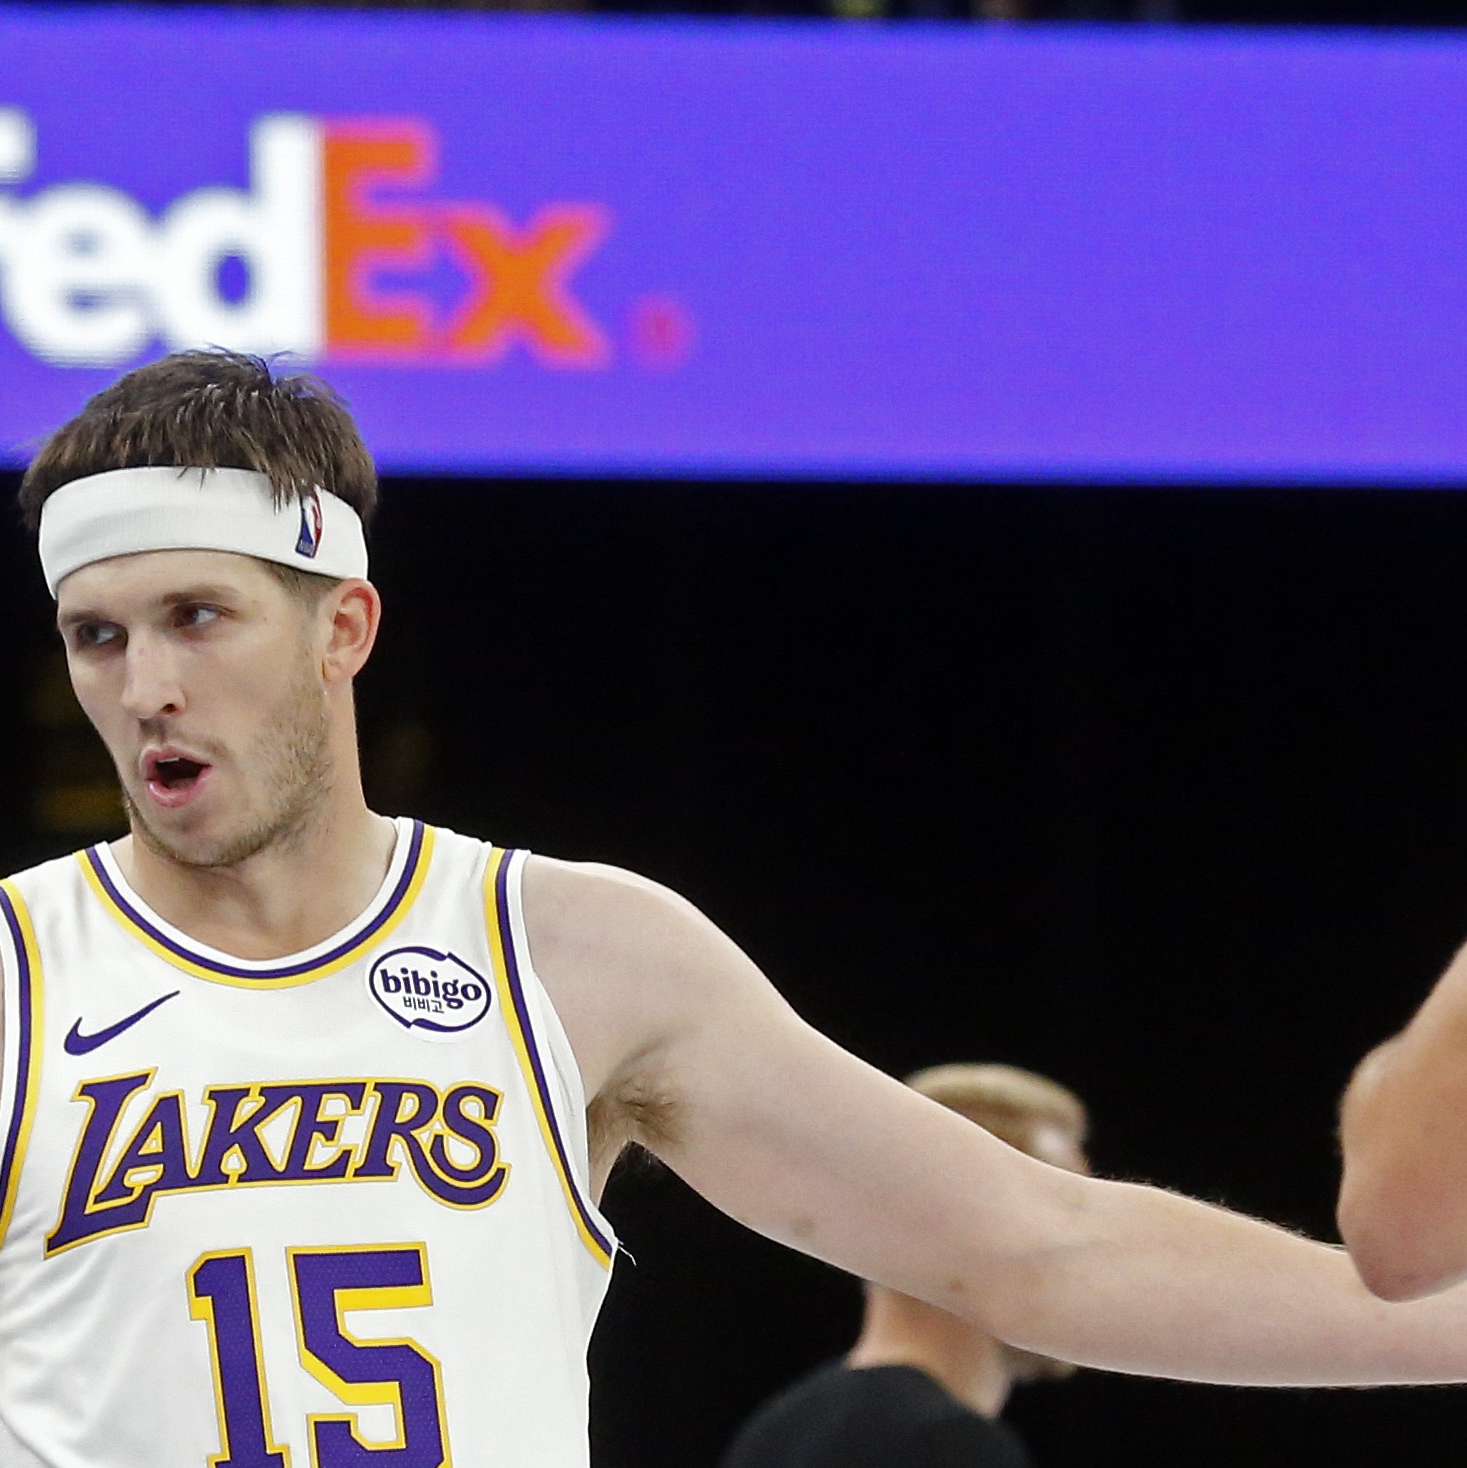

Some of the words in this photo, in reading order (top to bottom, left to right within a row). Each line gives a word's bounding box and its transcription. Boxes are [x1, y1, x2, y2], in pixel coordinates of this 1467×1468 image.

[379, 966, 483, 1010] bibigo
[402, 995, 446, 1014] 비비고
[43, 1066, 511, 1260] LAKERS
